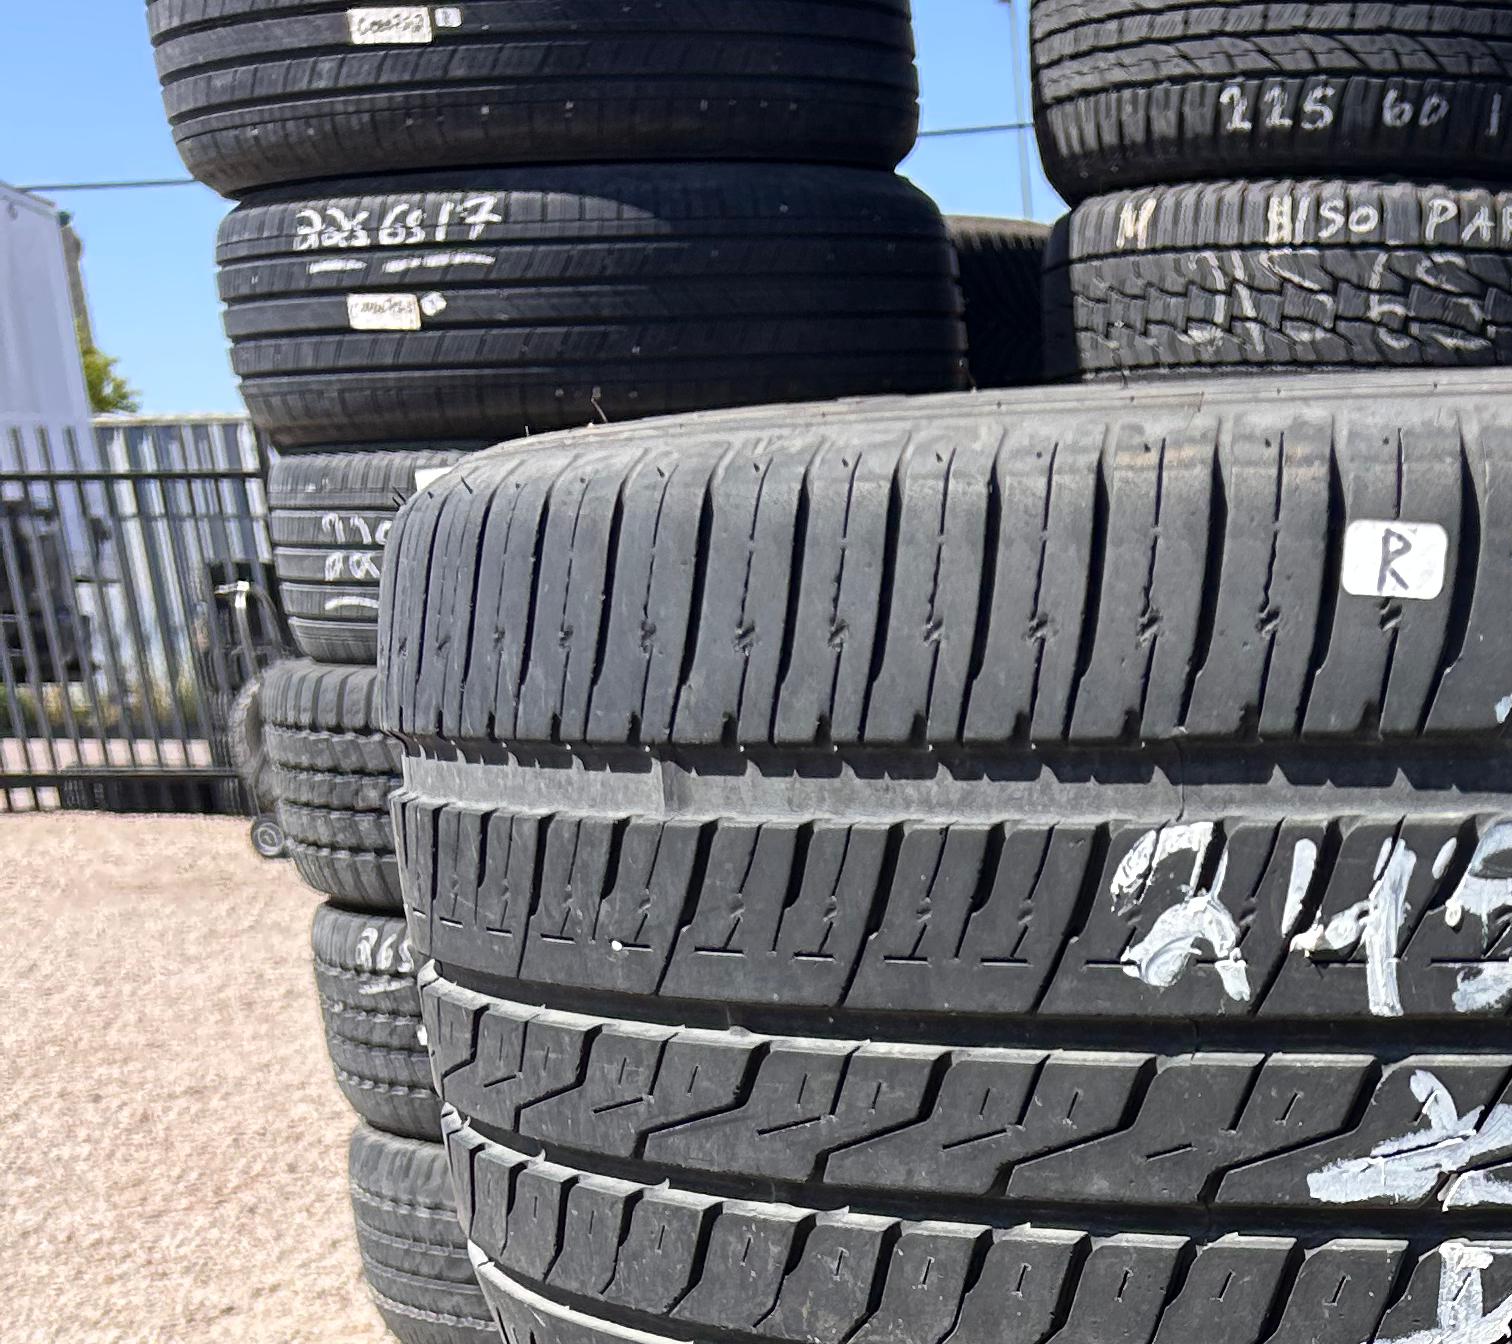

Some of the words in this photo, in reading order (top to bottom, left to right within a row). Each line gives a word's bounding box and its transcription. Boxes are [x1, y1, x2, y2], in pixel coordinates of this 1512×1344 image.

[1219, 86, 1336, 133] 225
[1381, 88, 1450, 128] 60
[434, 196, 502, 242] 17
[1377, 529, 1412, 594] R
